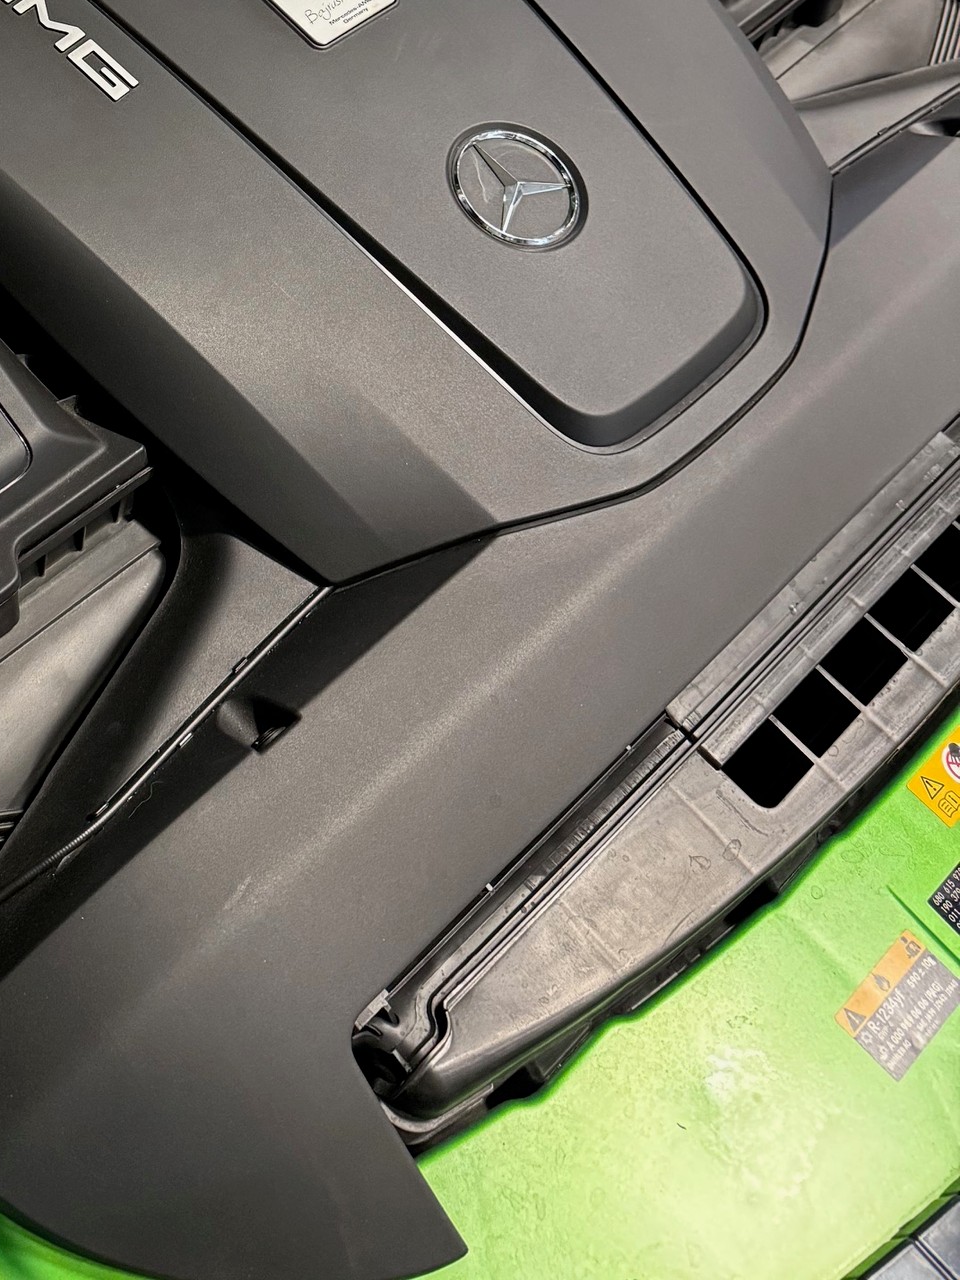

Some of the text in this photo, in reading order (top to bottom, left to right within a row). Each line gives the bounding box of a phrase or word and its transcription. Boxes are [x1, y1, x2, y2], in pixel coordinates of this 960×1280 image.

[343, 7, 369, 24] Germany
[933, 891, 945, 906] 680
[943, 879, 955, 894] 615
[941, 900, 953, 914] 190
[868, 988, 906, 1034] R-1234yf
